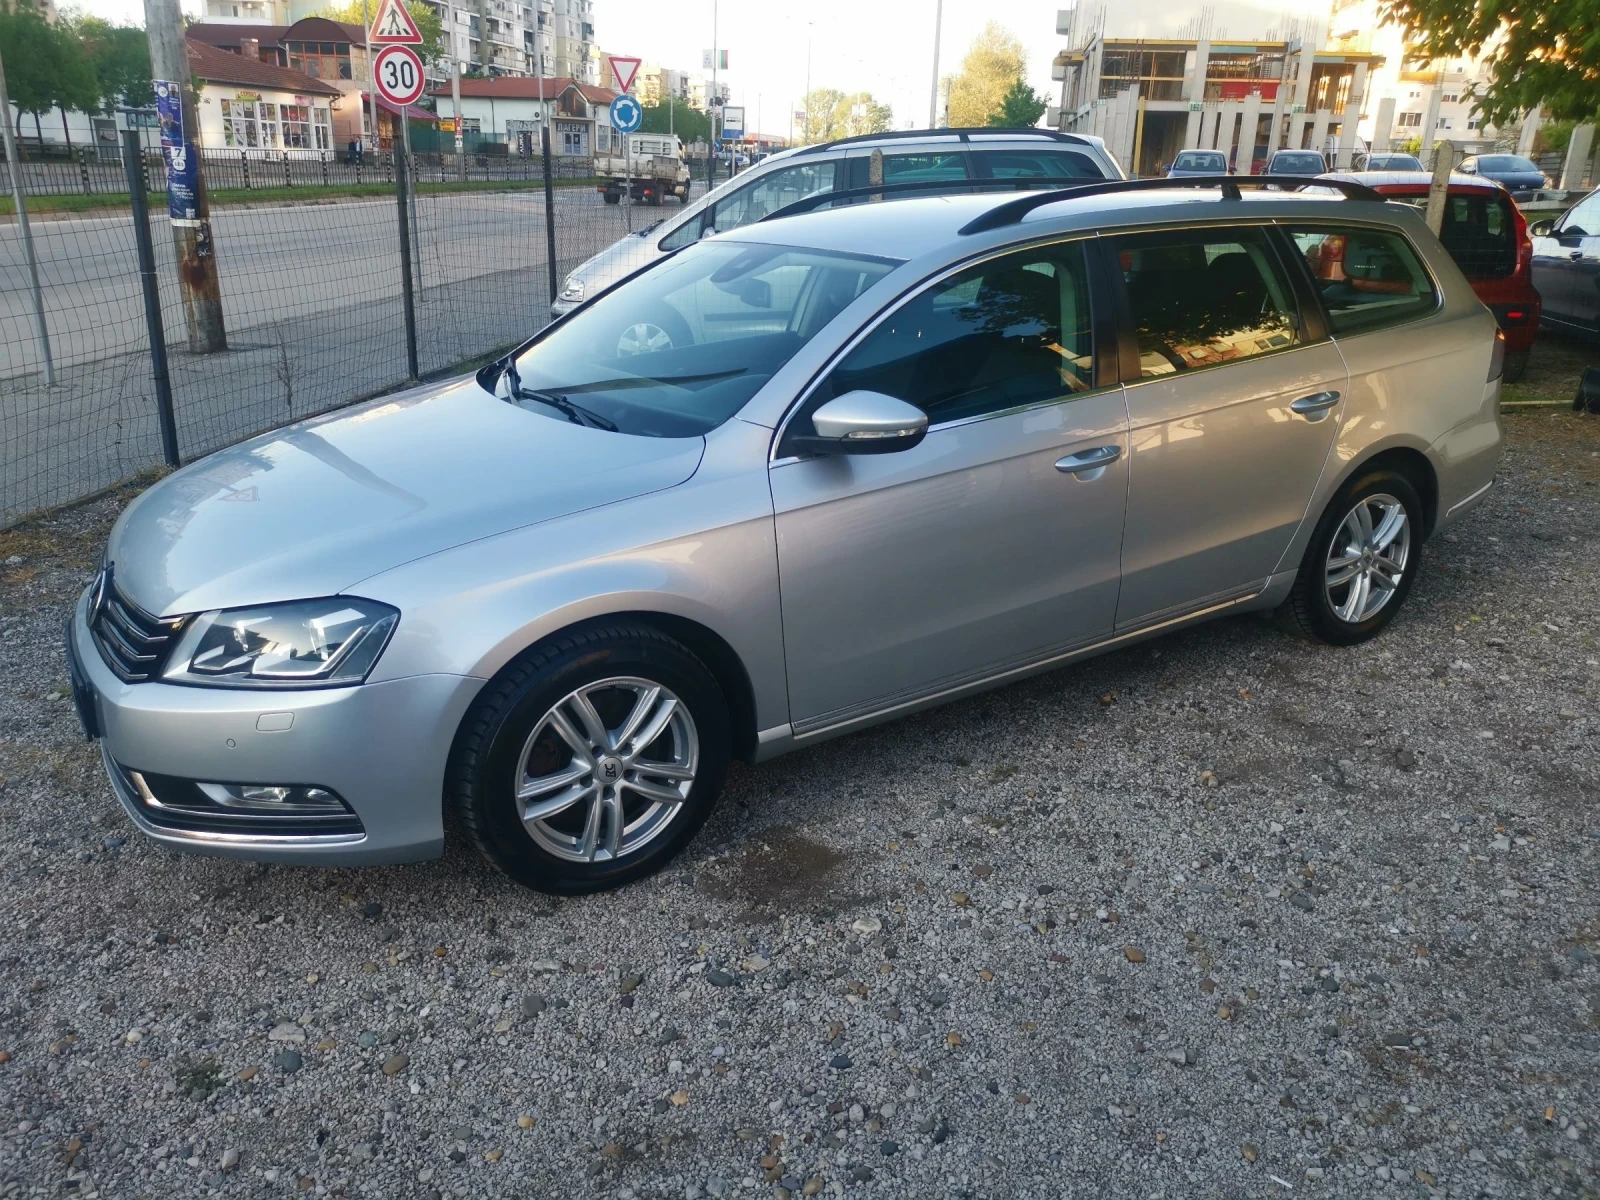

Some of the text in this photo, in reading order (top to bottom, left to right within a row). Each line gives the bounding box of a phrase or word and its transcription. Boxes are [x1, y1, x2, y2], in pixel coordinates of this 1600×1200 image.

[385, 61, 414, 89] 30
[557, 123, 586, 132] ЛАГЕРИ
[174, 148, 182, 157] 7
